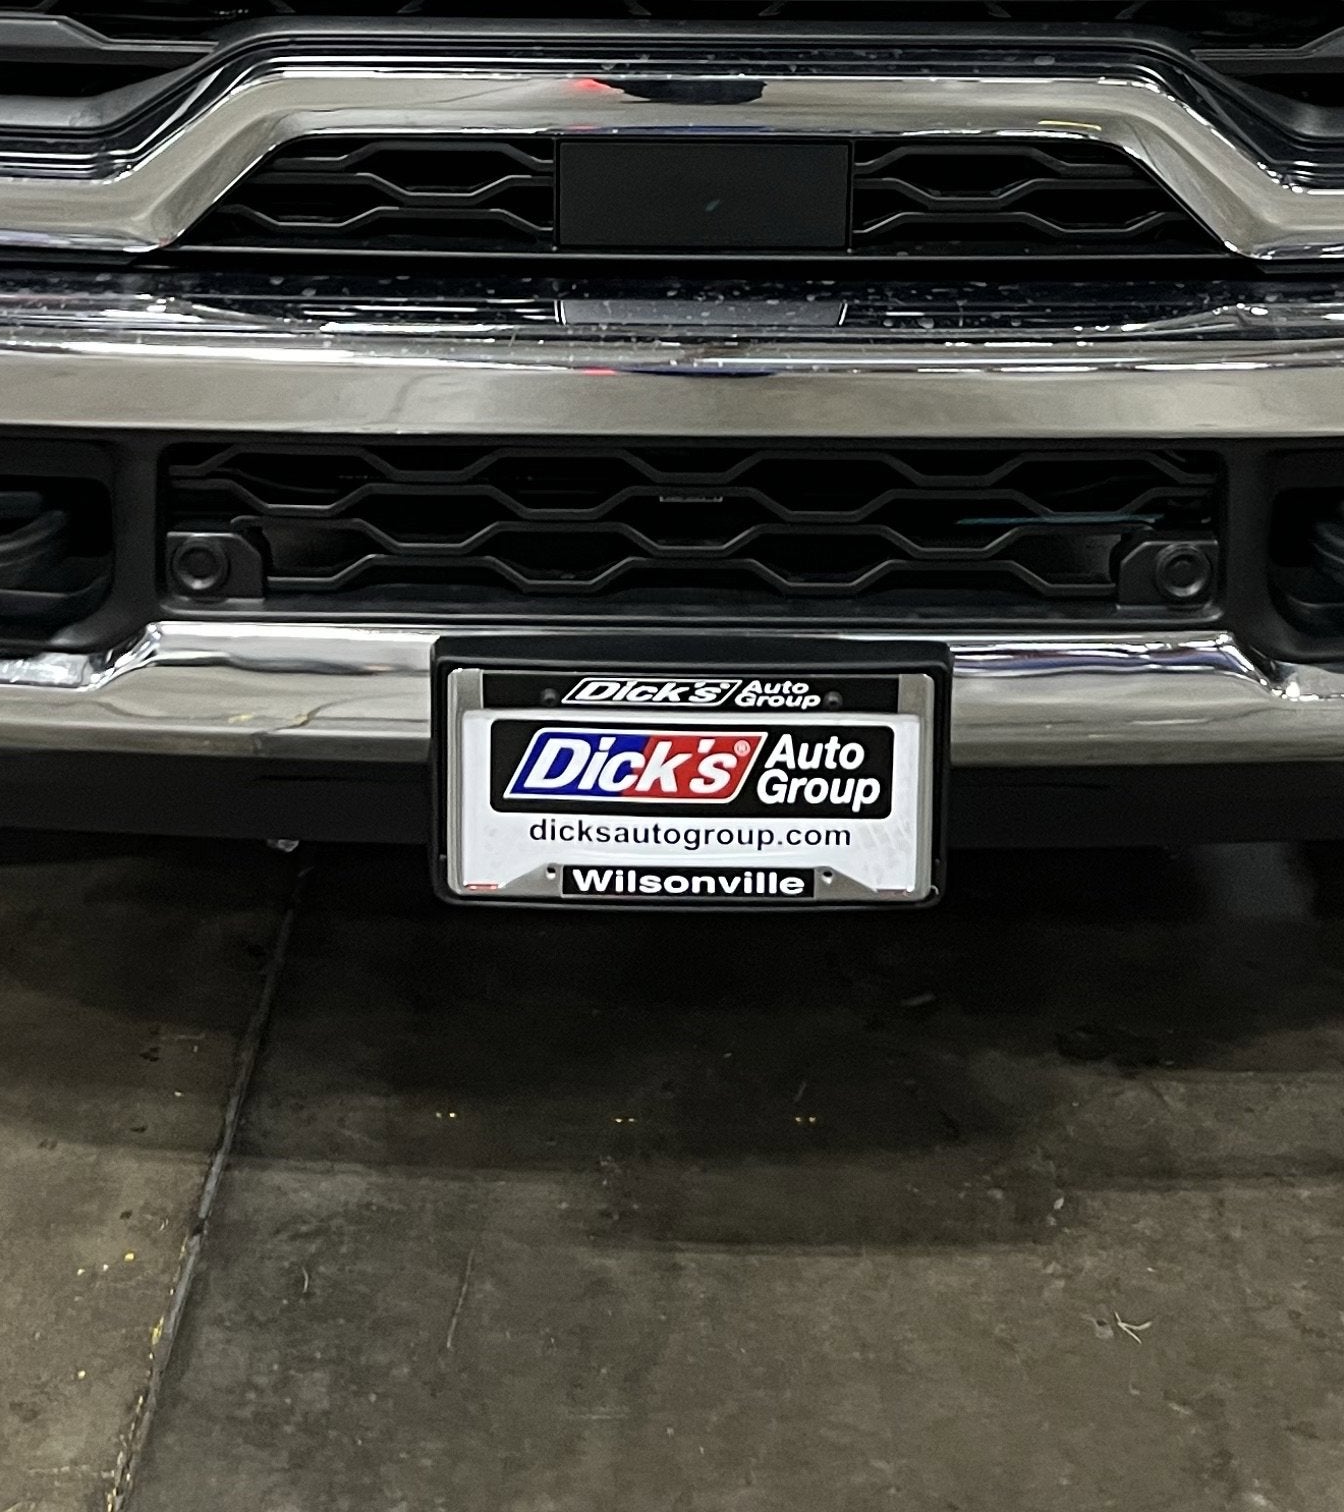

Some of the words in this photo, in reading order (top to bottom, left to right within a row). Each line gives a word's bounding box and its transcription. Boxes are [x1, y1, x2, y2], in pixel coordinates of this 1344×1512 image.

[734, 693, 821, 710] Group
[742, 679, 809, 695] Auto
[764, 733, 865, 770] Auto
[756, 768, 881, 812] Group
[529, 816, 852, 850] dicksautogroup.com
[571, 868, 805, 895] Wilsonville
